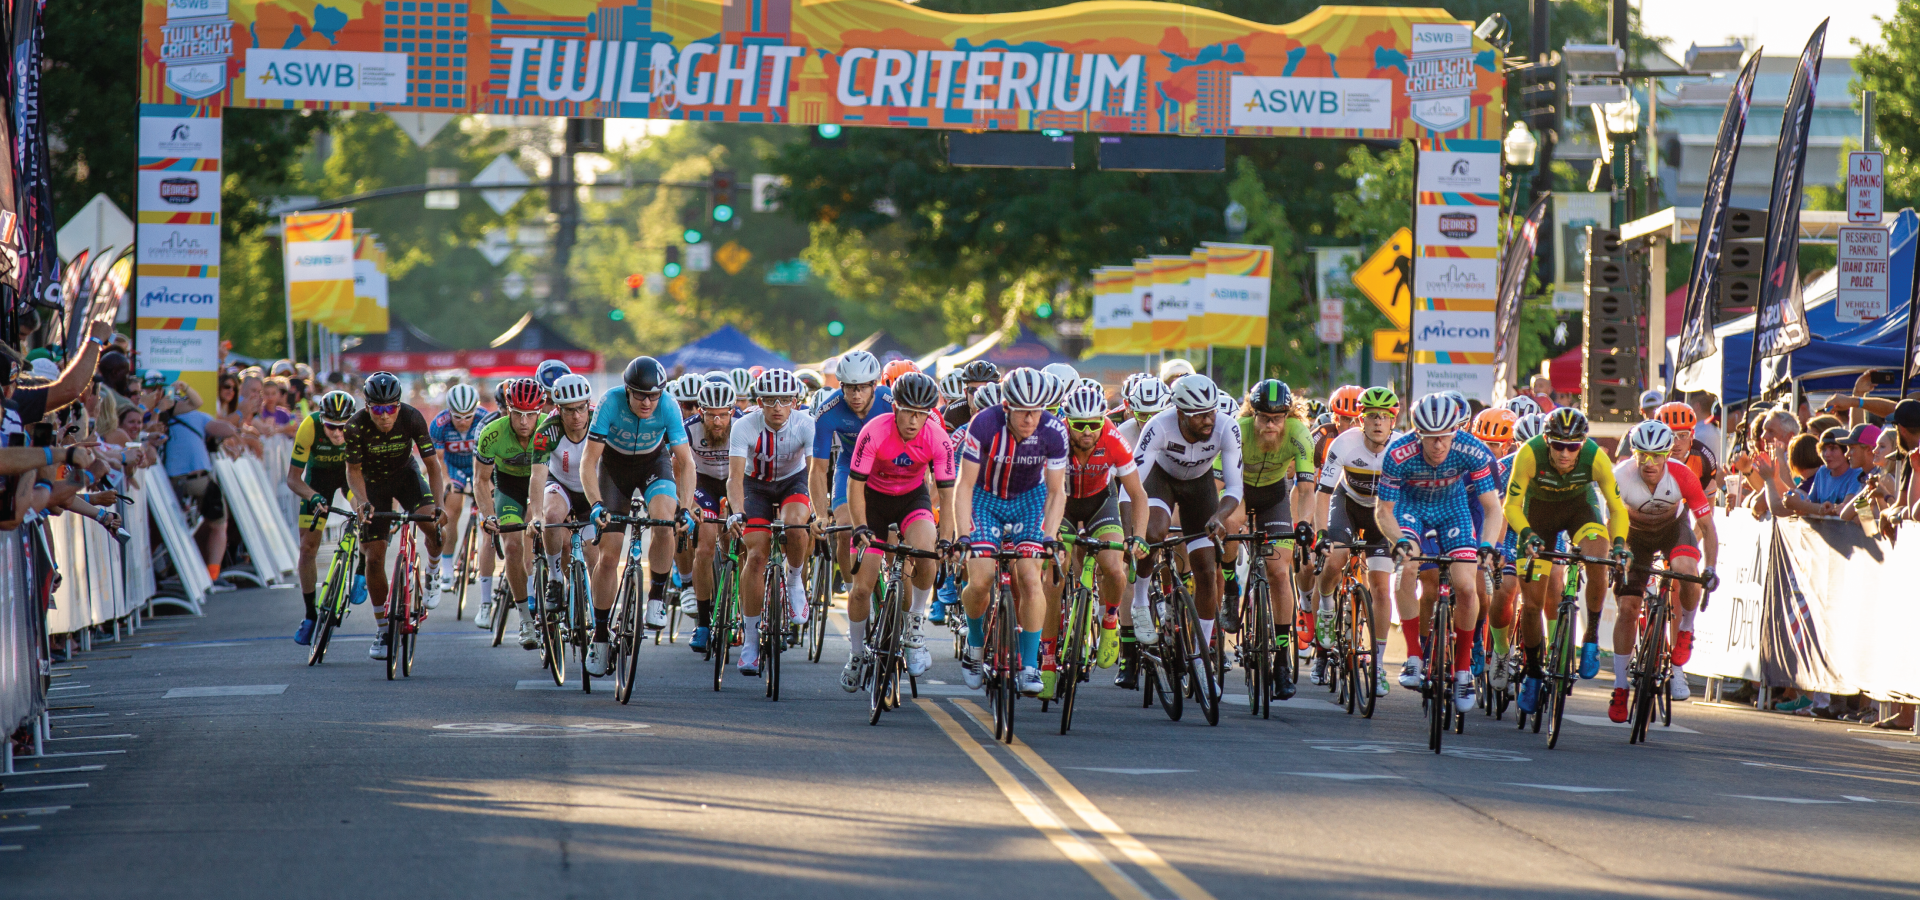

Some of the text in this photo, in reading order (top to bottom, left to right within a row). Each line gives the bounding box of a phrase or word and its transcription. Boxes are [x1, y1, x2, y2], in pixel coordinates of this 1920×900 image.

[1415, 31, 1454, 43] ASWB
[160, 39, 233, 59] CRITERIUM
[261, 62, 354, 88] ASWB
[836, 47, 1142, 112] CRITERIUM
[1404, 72, 1477, 93] CRITERIUM
[1246, 89, 1339, 114] ASWB
[1860, 159, 1872, 172] NO
[1850, 174, 1881, 188] PARKING
[161, 184, 197, 196] GEORGE'S
[1859, 190, 1871, 198] ANY
[1858, 200, 1872, 209] TIME
[1440, 218, 1476, 231] GEORGE'S
[1845, 232, 1882, 243] RESERVED
[1849, 245, 1878, 256] PARKING
[1842, 262, 1886, 273] IDAHO STATE
[1850, 276, 1874, 287] POLICE
[140, 286, 214, 308] Micron
[1845, 301, 1881, 309] VEHICLES
[1853, 309, 1872, 317] ONLY
[1419, 320, 1490, 341] Micron
[1427, 370, 1478, 380] Washington
[1140, 427, 1156, 452] CNCPT
[854, 432, 872, 468] cutaway
[1395, 443, 1418, 461] CLIF
